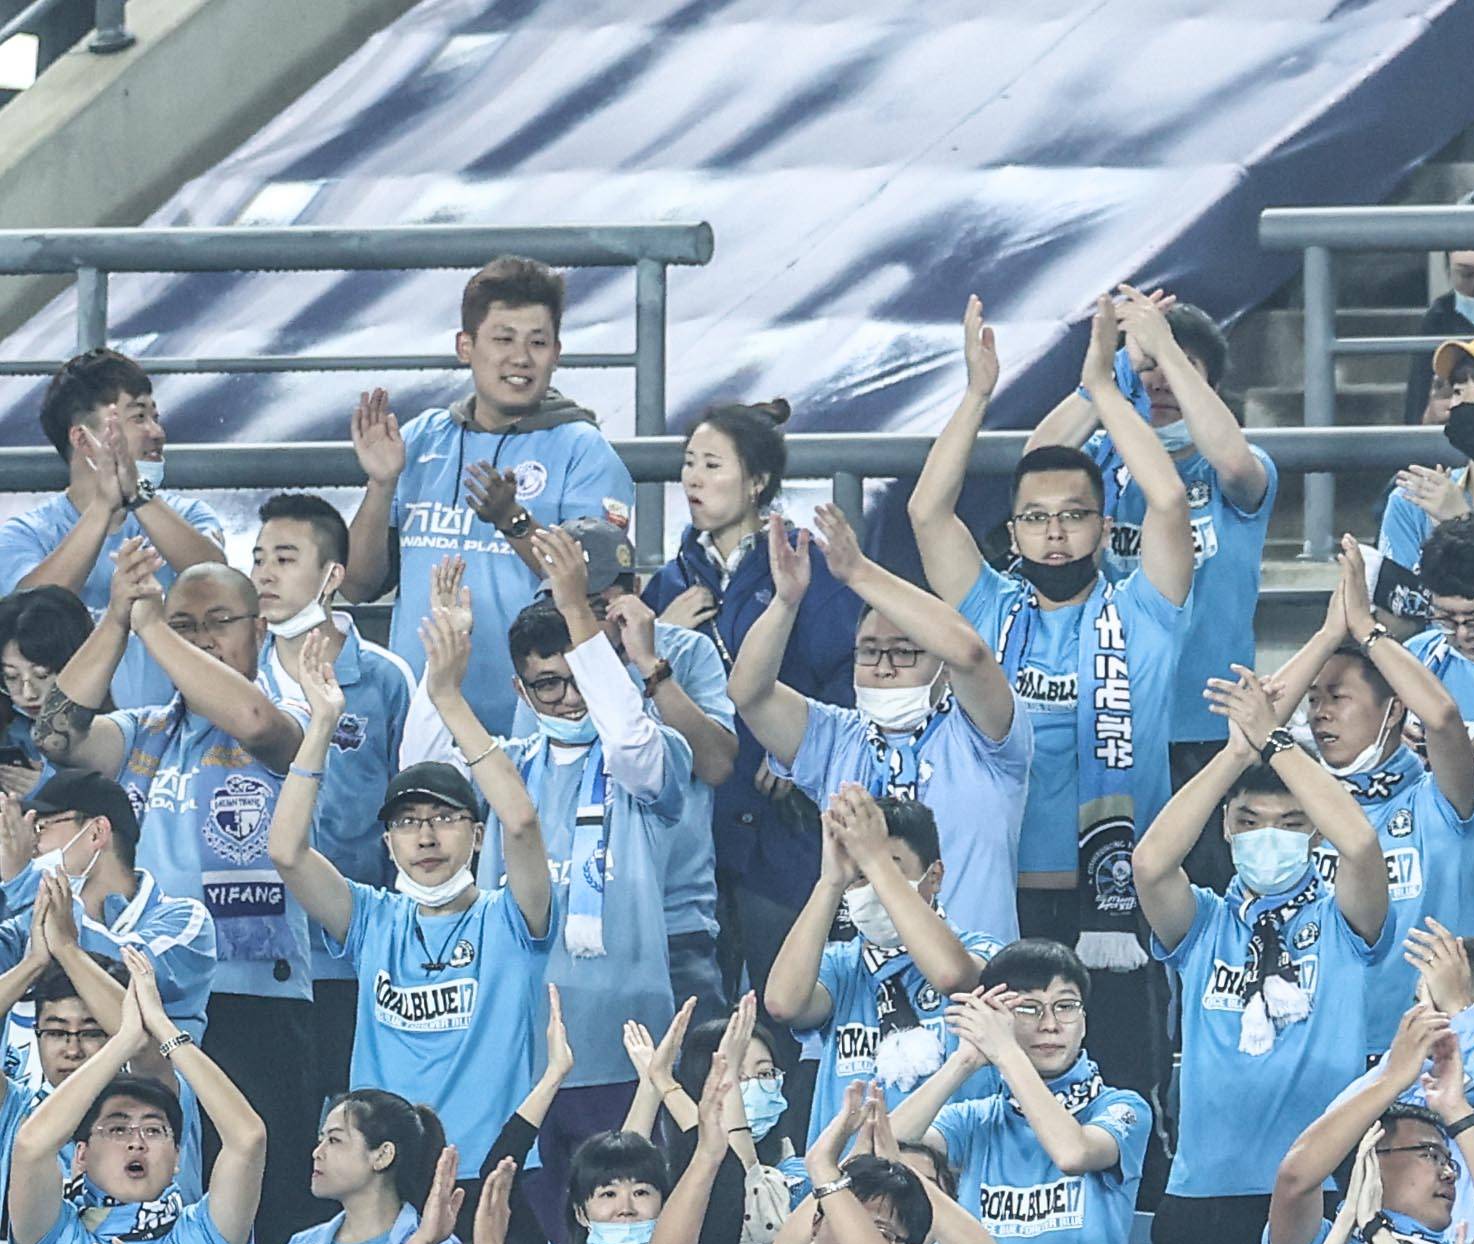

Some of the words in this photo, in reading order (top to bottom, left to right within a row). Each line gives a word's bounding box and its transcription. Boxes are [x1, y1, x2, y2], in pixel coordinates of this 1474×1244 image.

[401, 535, 459, 551] WANDA
[208, 885, 284, 909] YIFANG
[981, 1181, 1082, 1222] ROYALBLUE17
